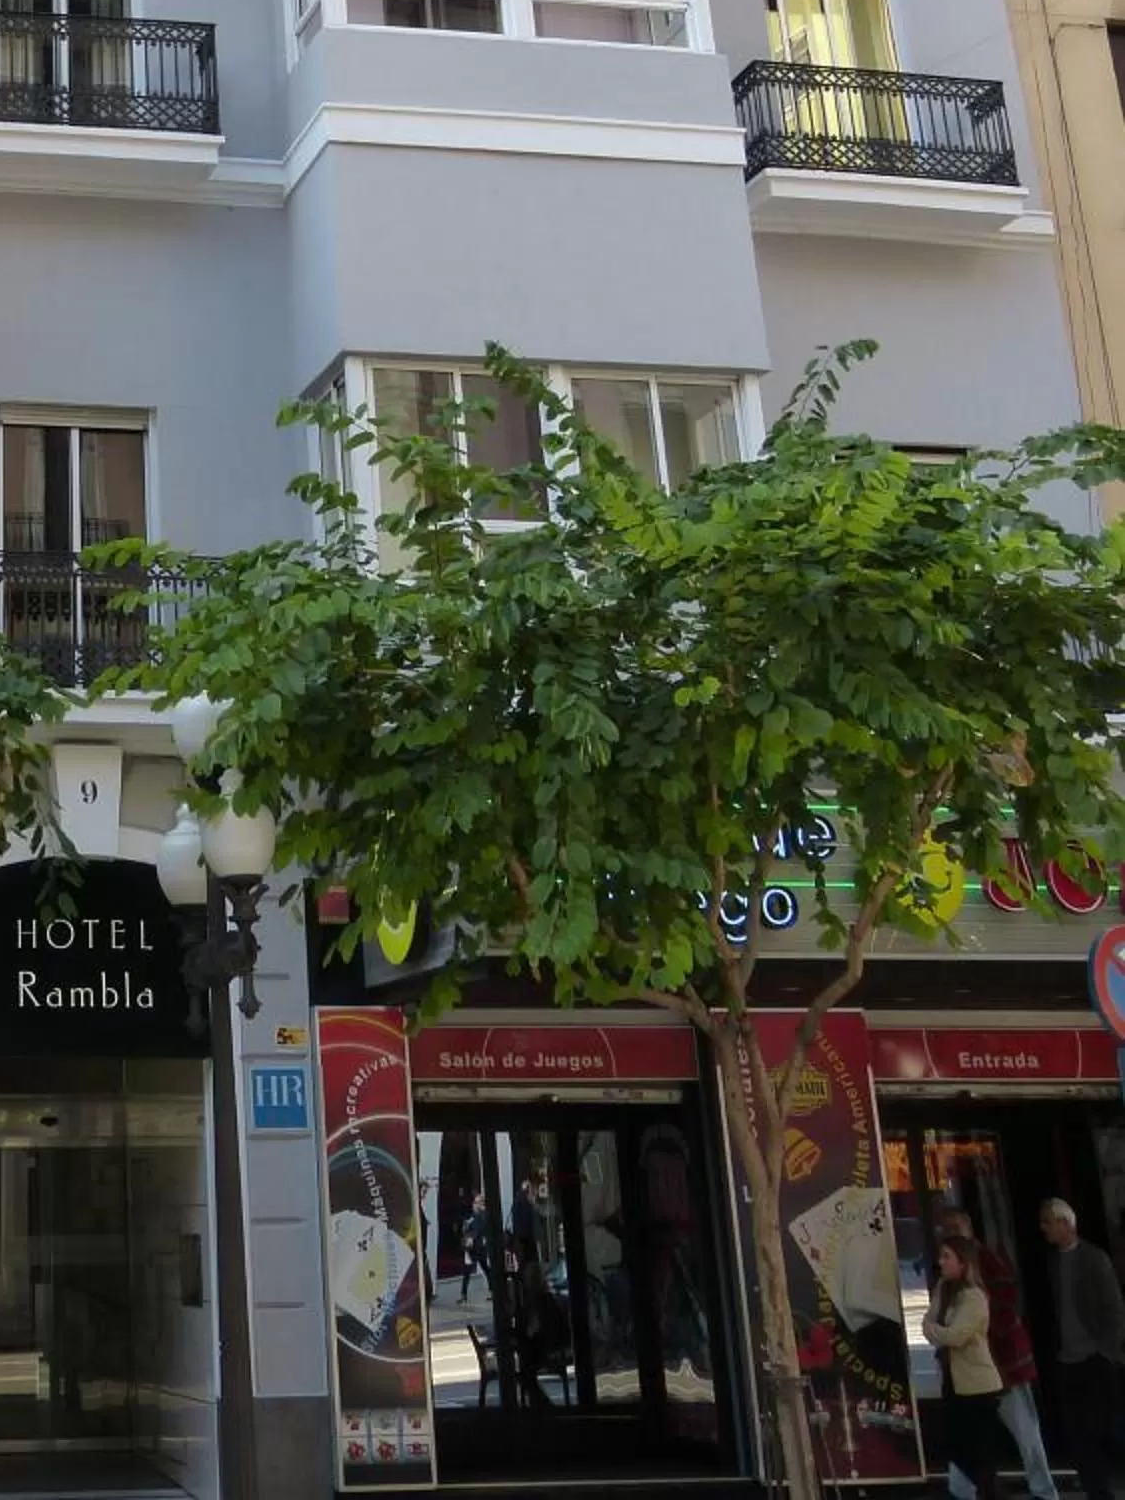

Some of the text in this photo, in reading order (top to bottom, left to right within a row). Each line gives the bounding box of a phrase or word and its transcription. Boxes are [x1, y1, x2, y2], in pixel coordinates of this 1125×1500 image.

[80, 779, 99, 804] 9
[16, 919, 154, 950] HOTEL
[17, 970, 155, 1009] Rambla
[501, 1051, 526, 1069] de
[533, 1051, 605, 1072] Juegos
[958, 1050, 1040, 1069] Entrada
[255, 1074, 303, 1108] HR
